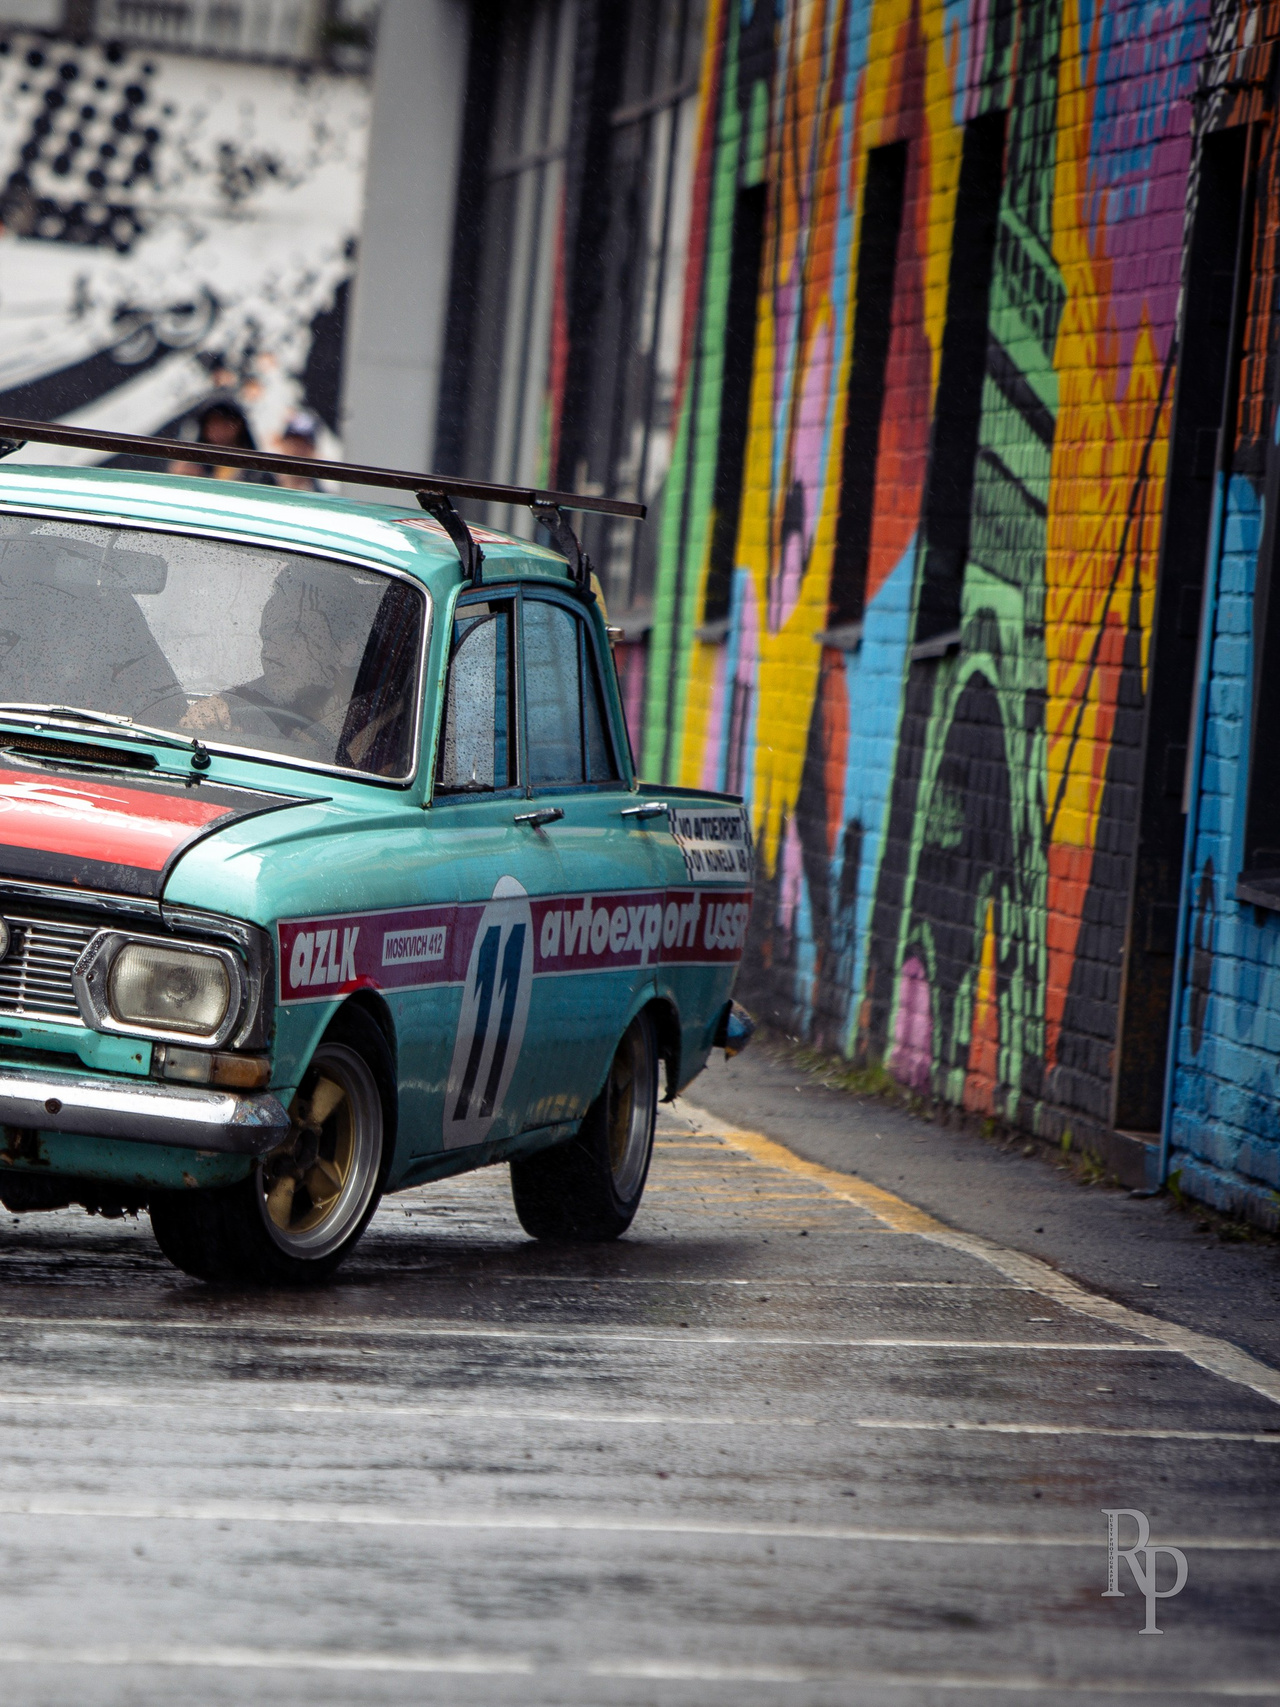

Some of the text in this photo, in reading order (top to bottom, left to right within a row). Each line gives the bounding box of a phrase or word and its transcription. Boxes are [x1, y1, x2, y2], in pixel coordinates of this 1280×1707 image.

[694, 816, 742, 841] AVTOEXPORT
[385, 933, 443, 960] MOSKVICH 412
[540, 892, 701, 966] avtoexport
[452, 923, 526, 1122] 11
